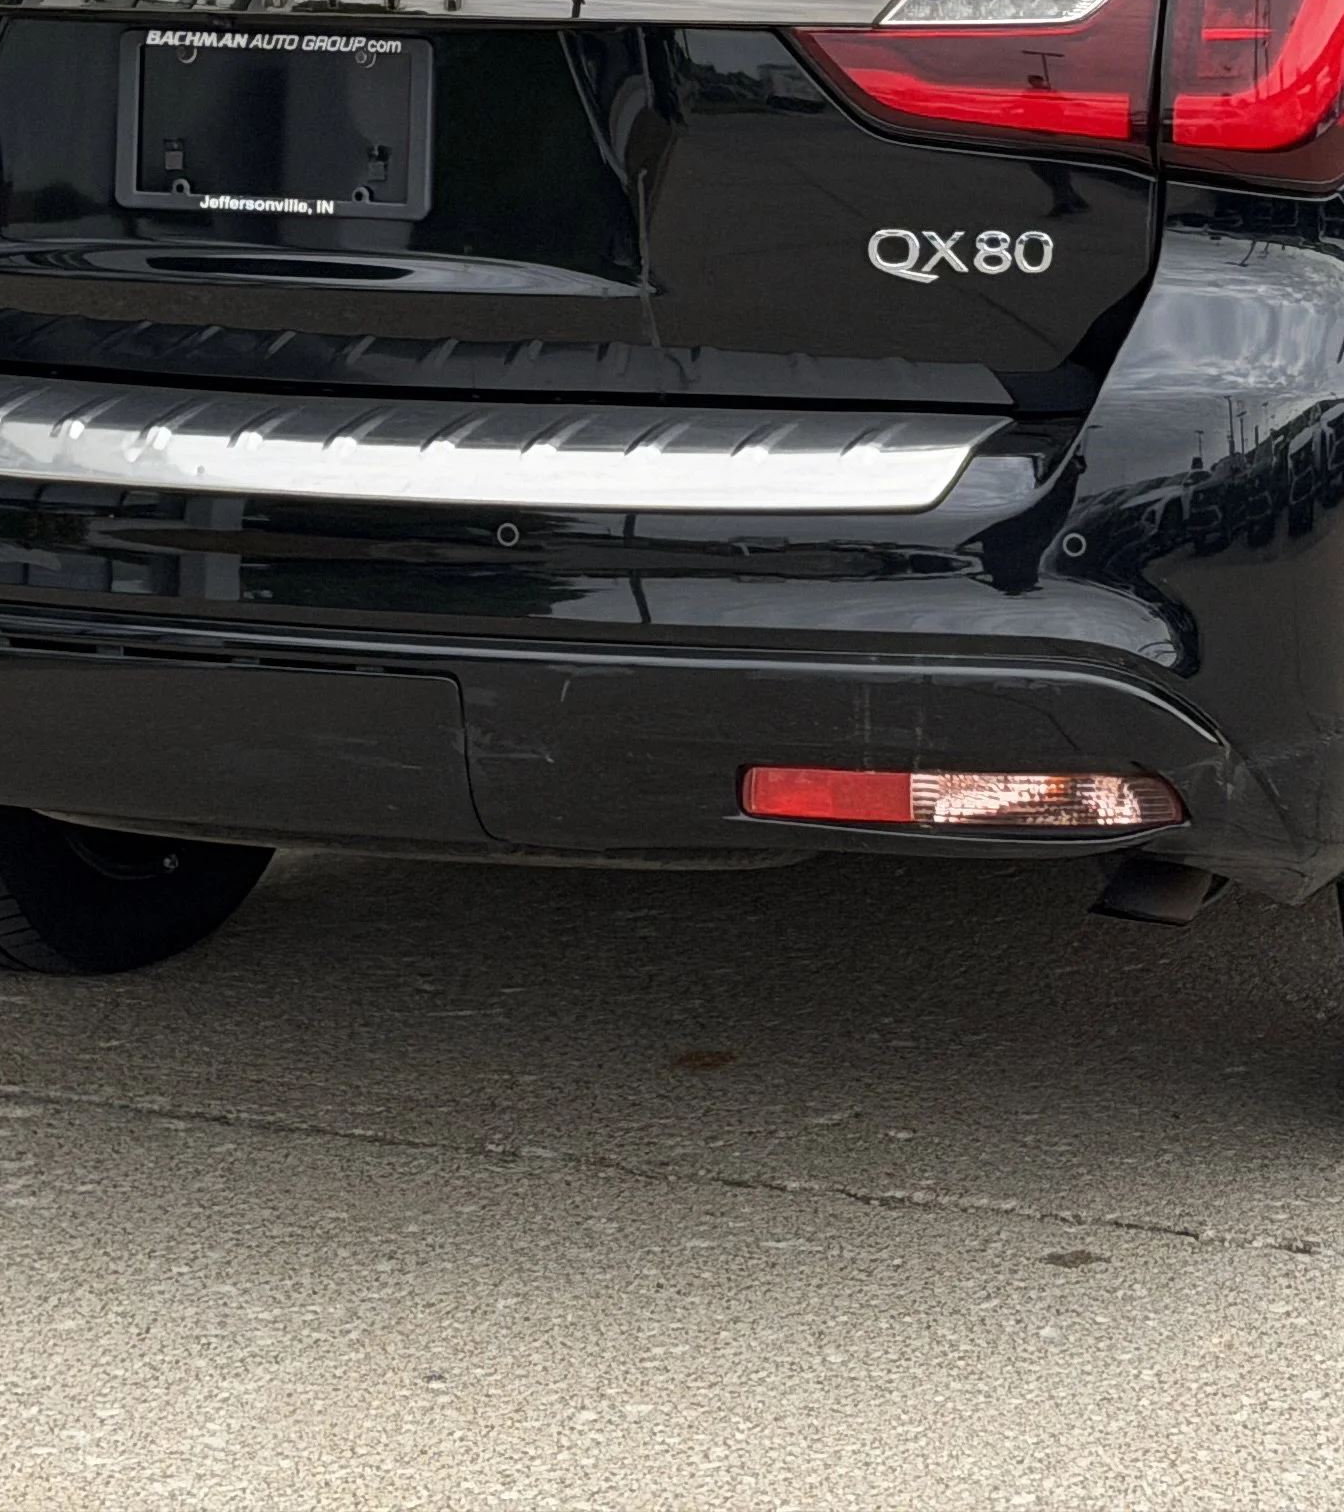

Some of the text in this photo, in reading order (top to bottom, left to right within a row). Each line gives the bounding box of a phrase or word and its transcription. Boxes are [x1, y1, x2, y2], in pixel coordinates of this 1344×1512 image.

[145, 29, 249, 49] BACHMAN
[248, 34, 300, 51] AUTO
[199, 194, 335, 215] Jeffersonville, IN
[867, 228, 1054, 284] QX80
